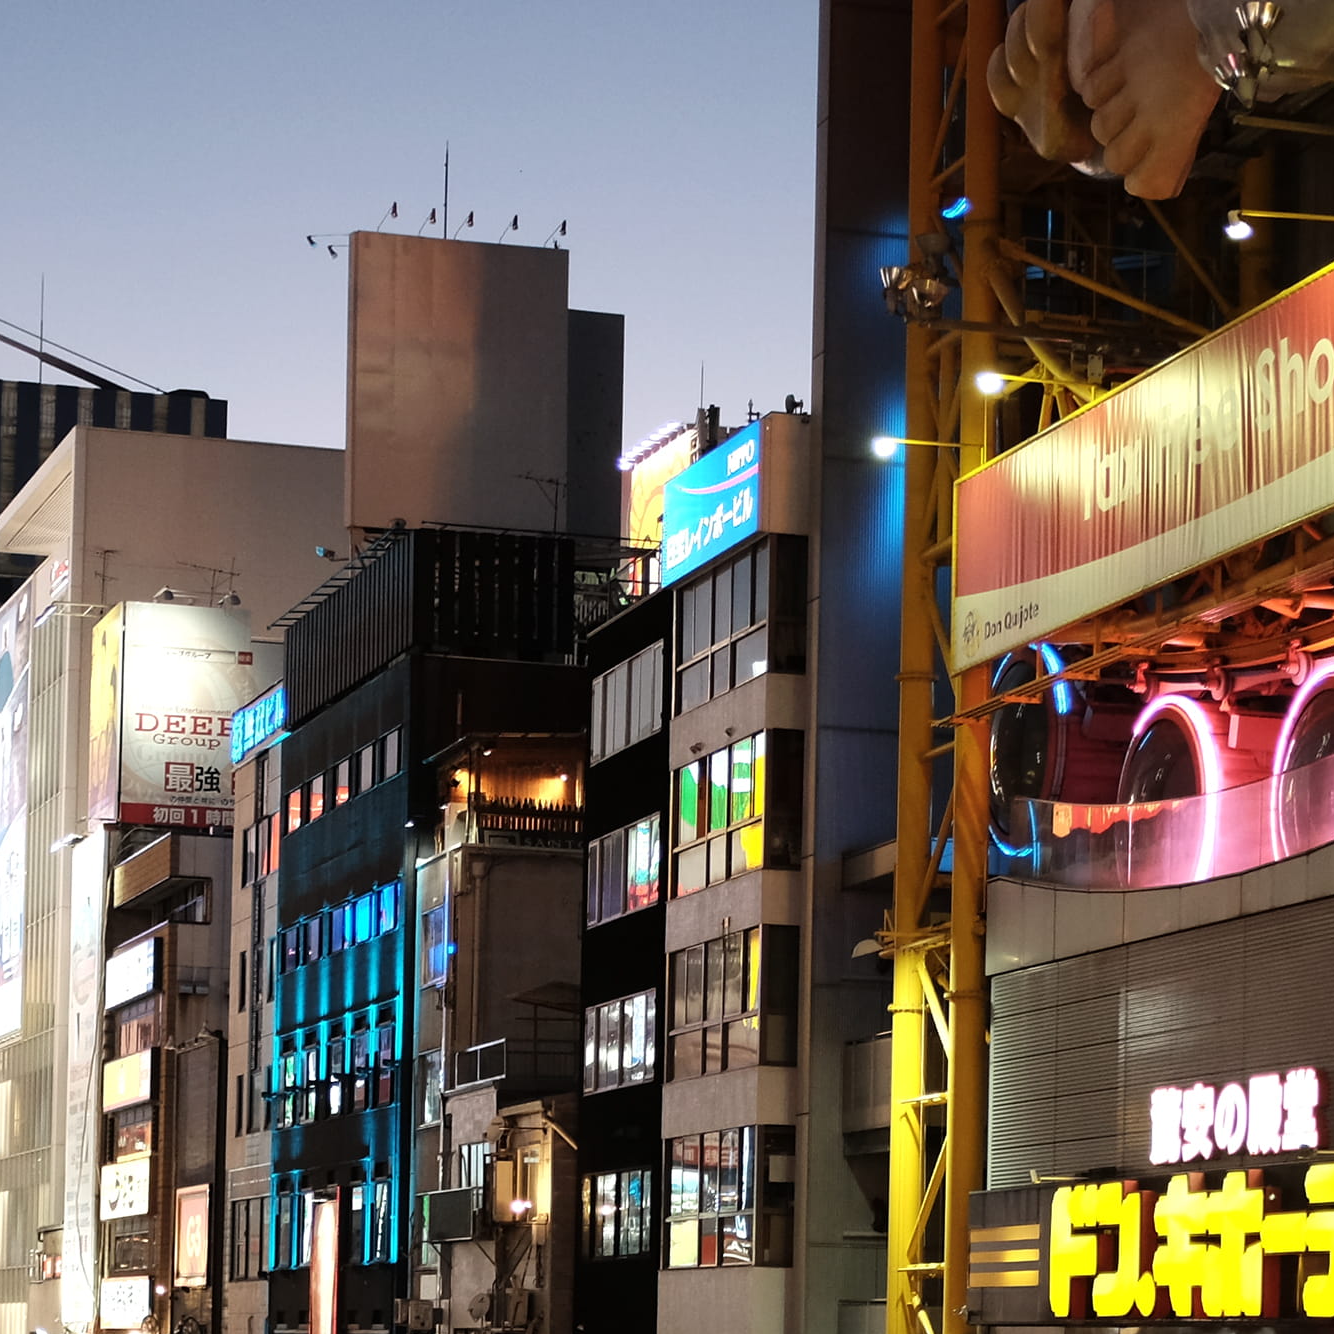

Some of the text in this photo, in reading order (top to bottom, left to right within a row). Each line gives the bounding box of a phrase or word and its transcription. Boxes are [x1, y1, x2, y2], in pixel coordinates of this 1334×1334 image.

[985, 602, 1039, 641] Don Quijote
[153, 733, 221, 750] Group
[166, 763, 220, 793] 最強
